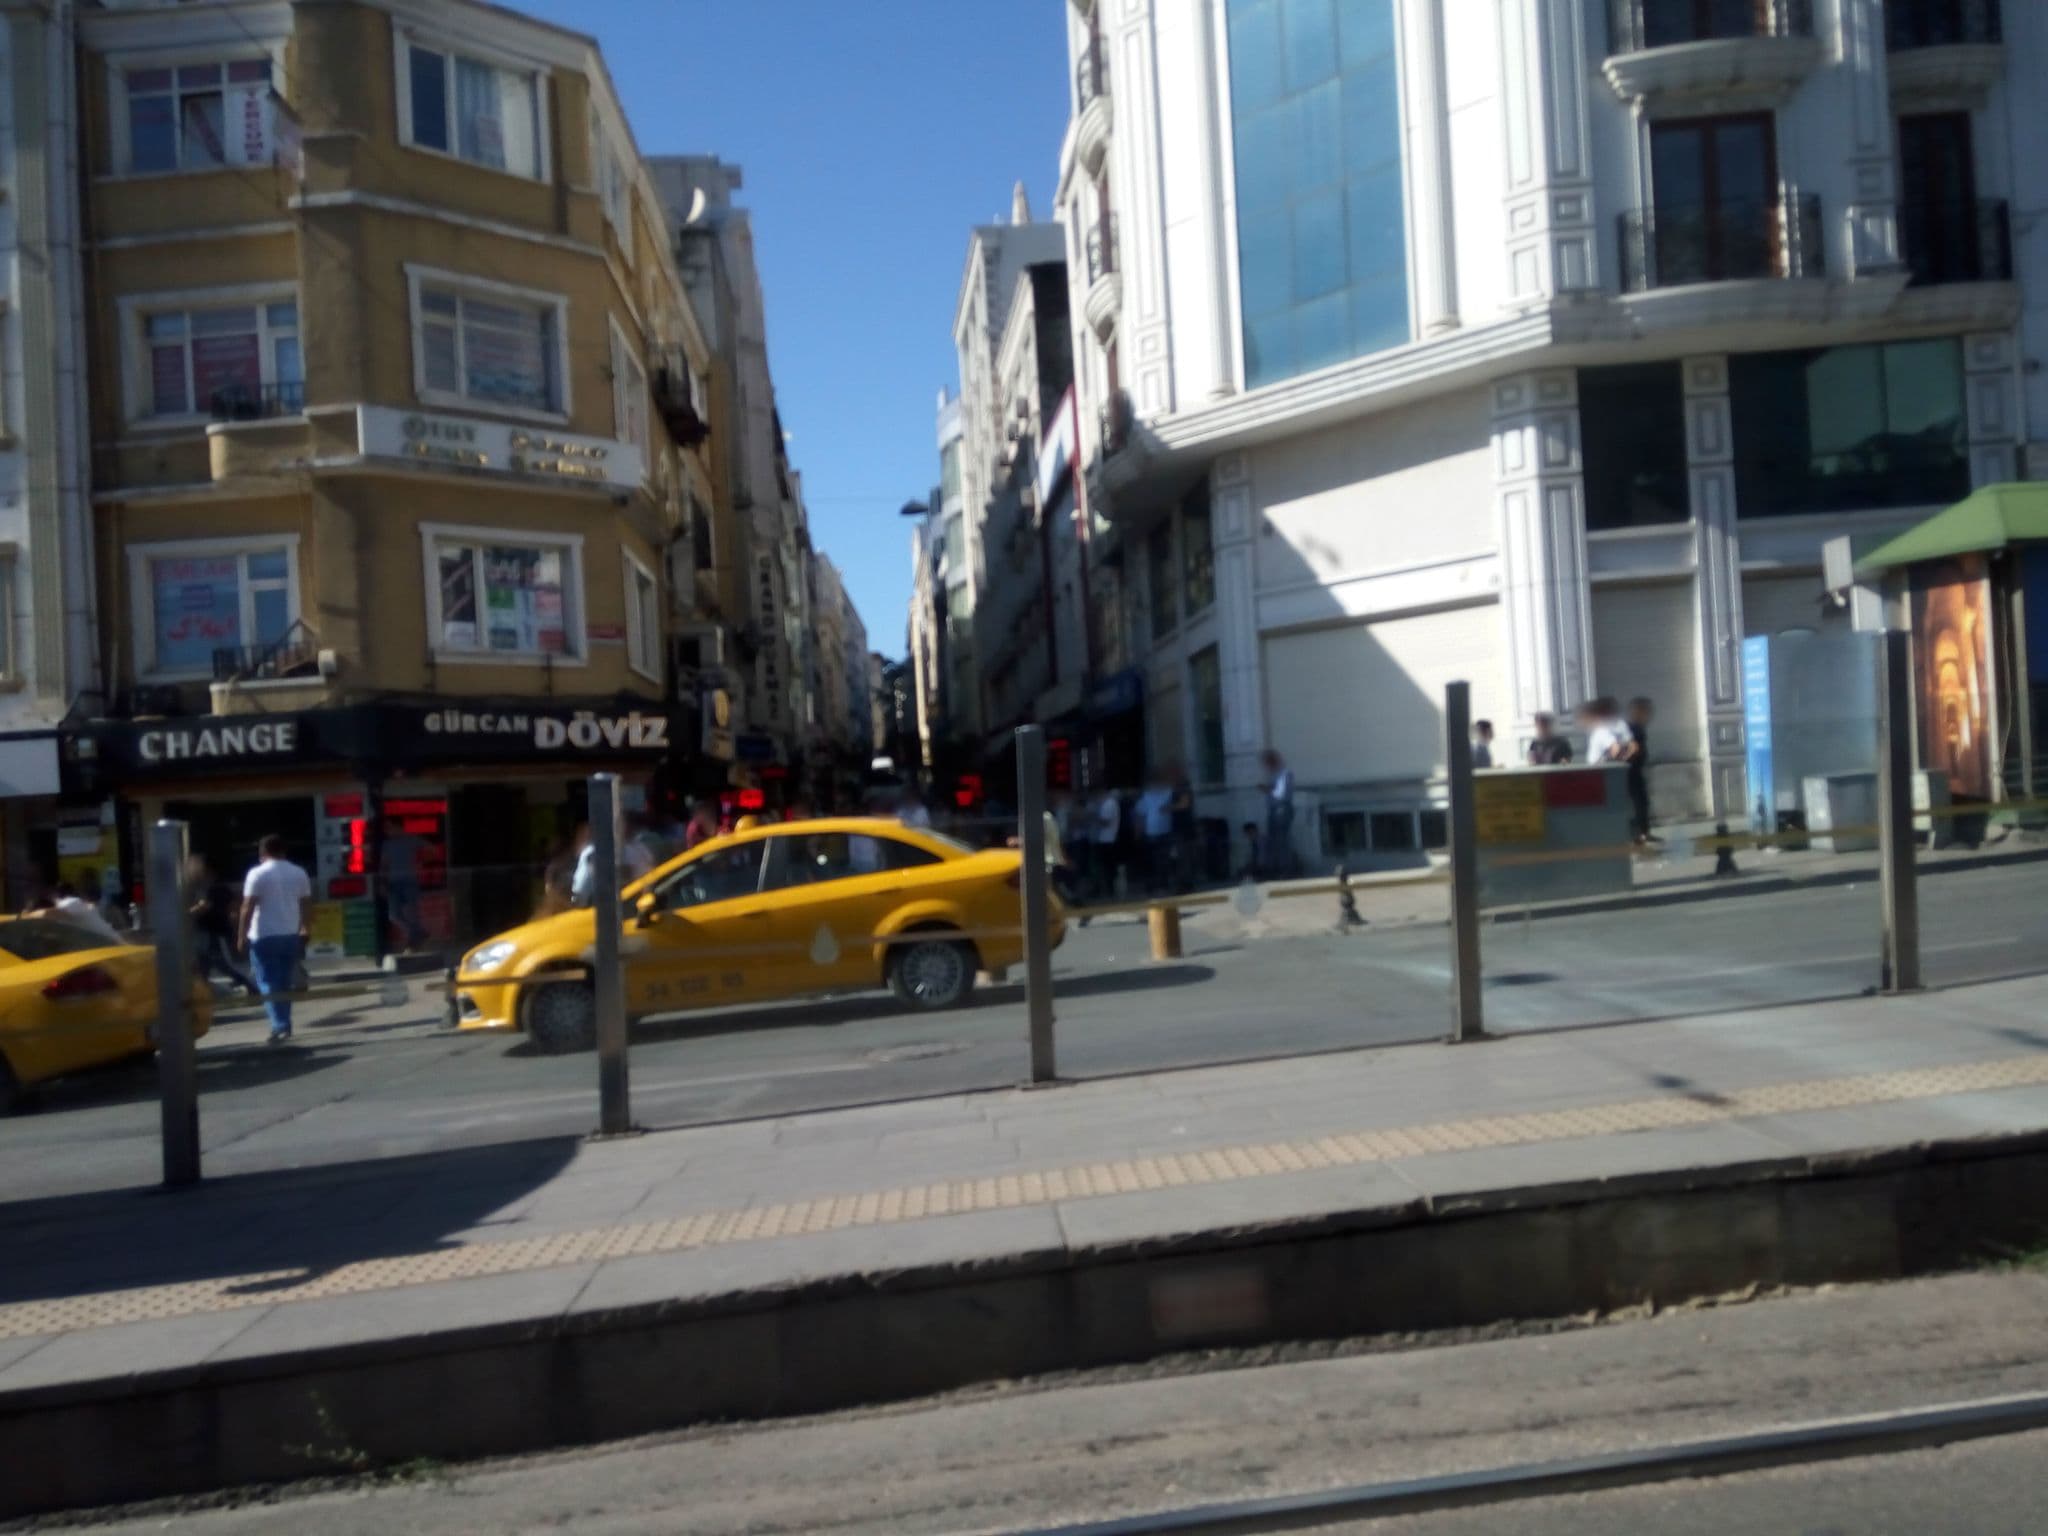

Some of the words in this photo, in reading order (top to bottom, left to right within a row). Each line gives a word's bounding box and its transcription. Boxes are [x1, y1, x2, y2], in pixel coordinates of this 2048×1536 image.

[139, 723, 295, 760] CHANGE
[424, 710, 528, 733] GÜRCAN
[534, 711, 669, 748] DÖVİZ
